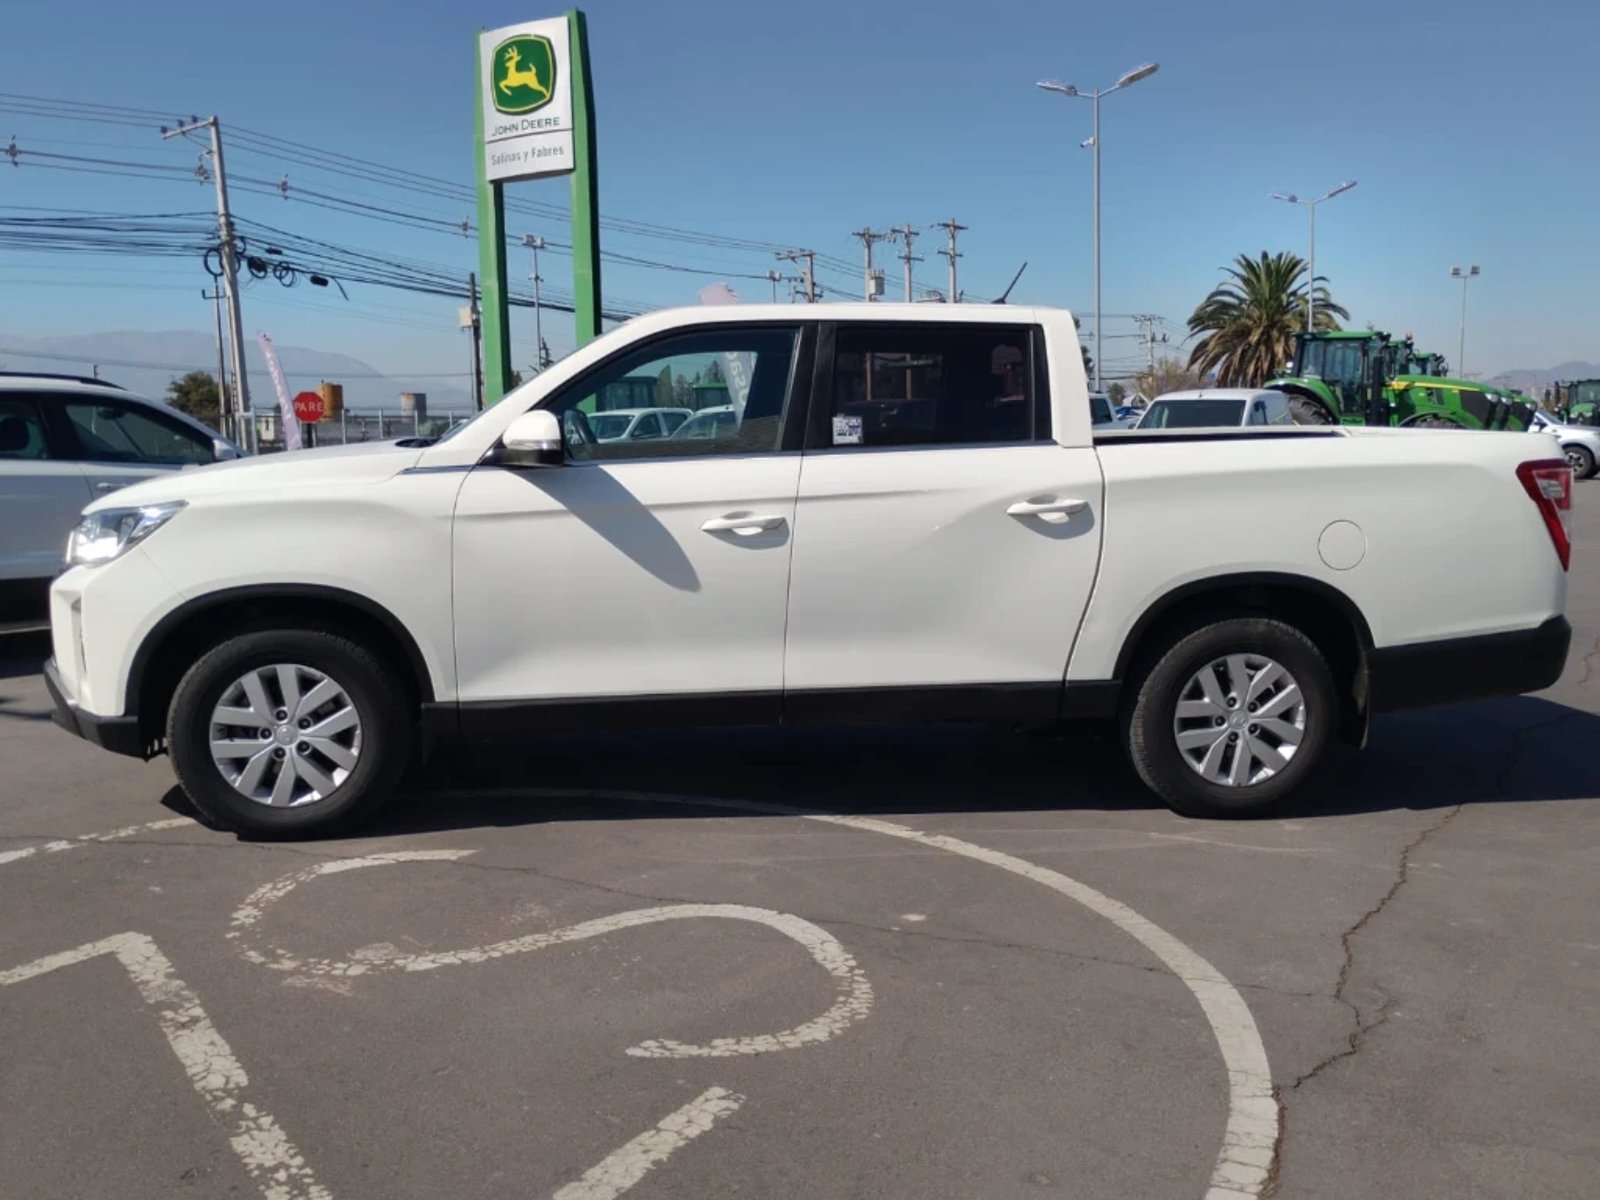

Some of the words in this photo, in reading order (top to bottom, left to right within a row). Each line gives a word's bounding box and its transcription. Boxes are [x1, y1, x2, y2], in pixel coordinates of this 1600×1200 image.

[491, 123, 519, 136] JOHN
[521, 117, 560, 131] DEERE
[491, 151, 521, 165] Salinas
[523, 150, 529, 163] y
[531, 146, 564, 158] Fabres
[295, 402, 324, 412] PARE
